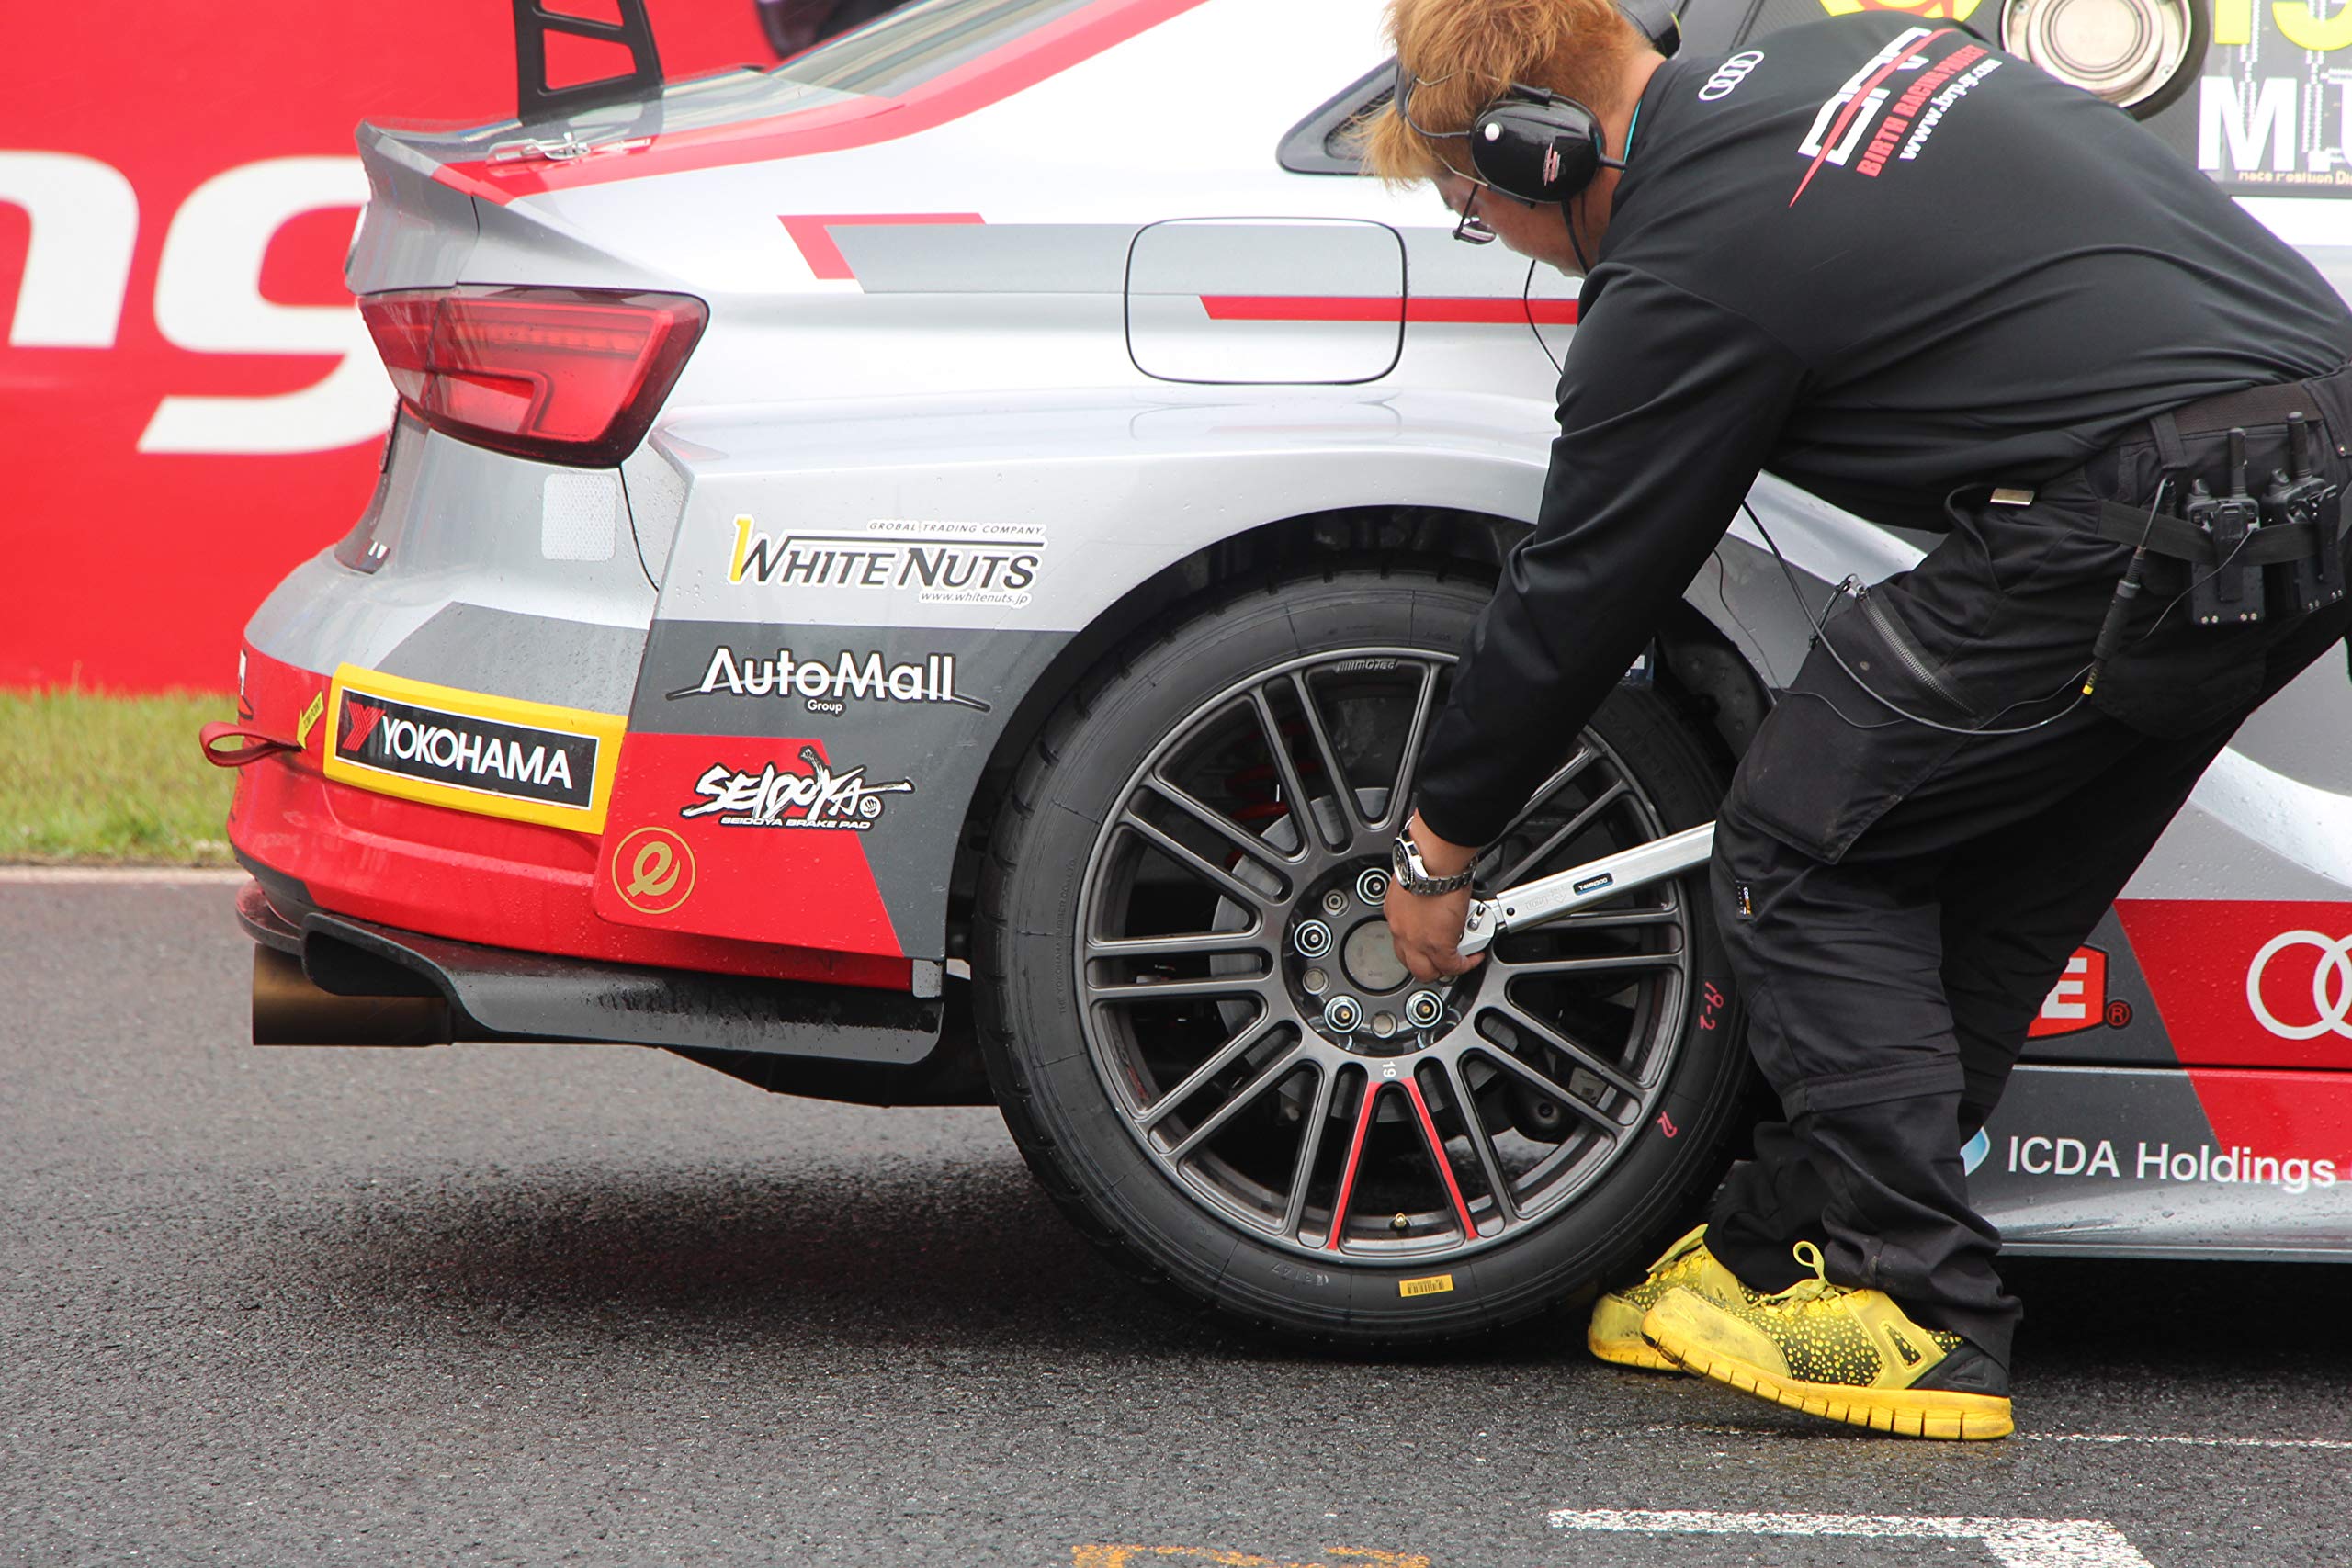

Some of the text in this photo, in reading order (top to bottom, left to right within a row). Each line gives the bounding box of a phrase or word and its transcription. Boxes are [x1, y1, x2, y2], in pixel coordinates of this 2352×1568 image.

[1856, 115, 1910, 178] BIRTH
[1892, 70, 1951, 118] RACING
[869, 522, 1043, 536] GROBAL TRADING COMPANY
[898, 547, 1039, 590] NUTS
[922, 592, 1028, 605] www.whitenuts.jp
[699, 647, 954, 701] AutoMall
[807, 699, 842, 715] Group
[382, 716, 573, 790] YOKOHAMA
[720, 816, 871, 829] SEIDOYA BRAKE PAD
[1382, 1061, 1396, 1078] 19
[2007, 1135, 2337, 1194] ICDA Holdings
